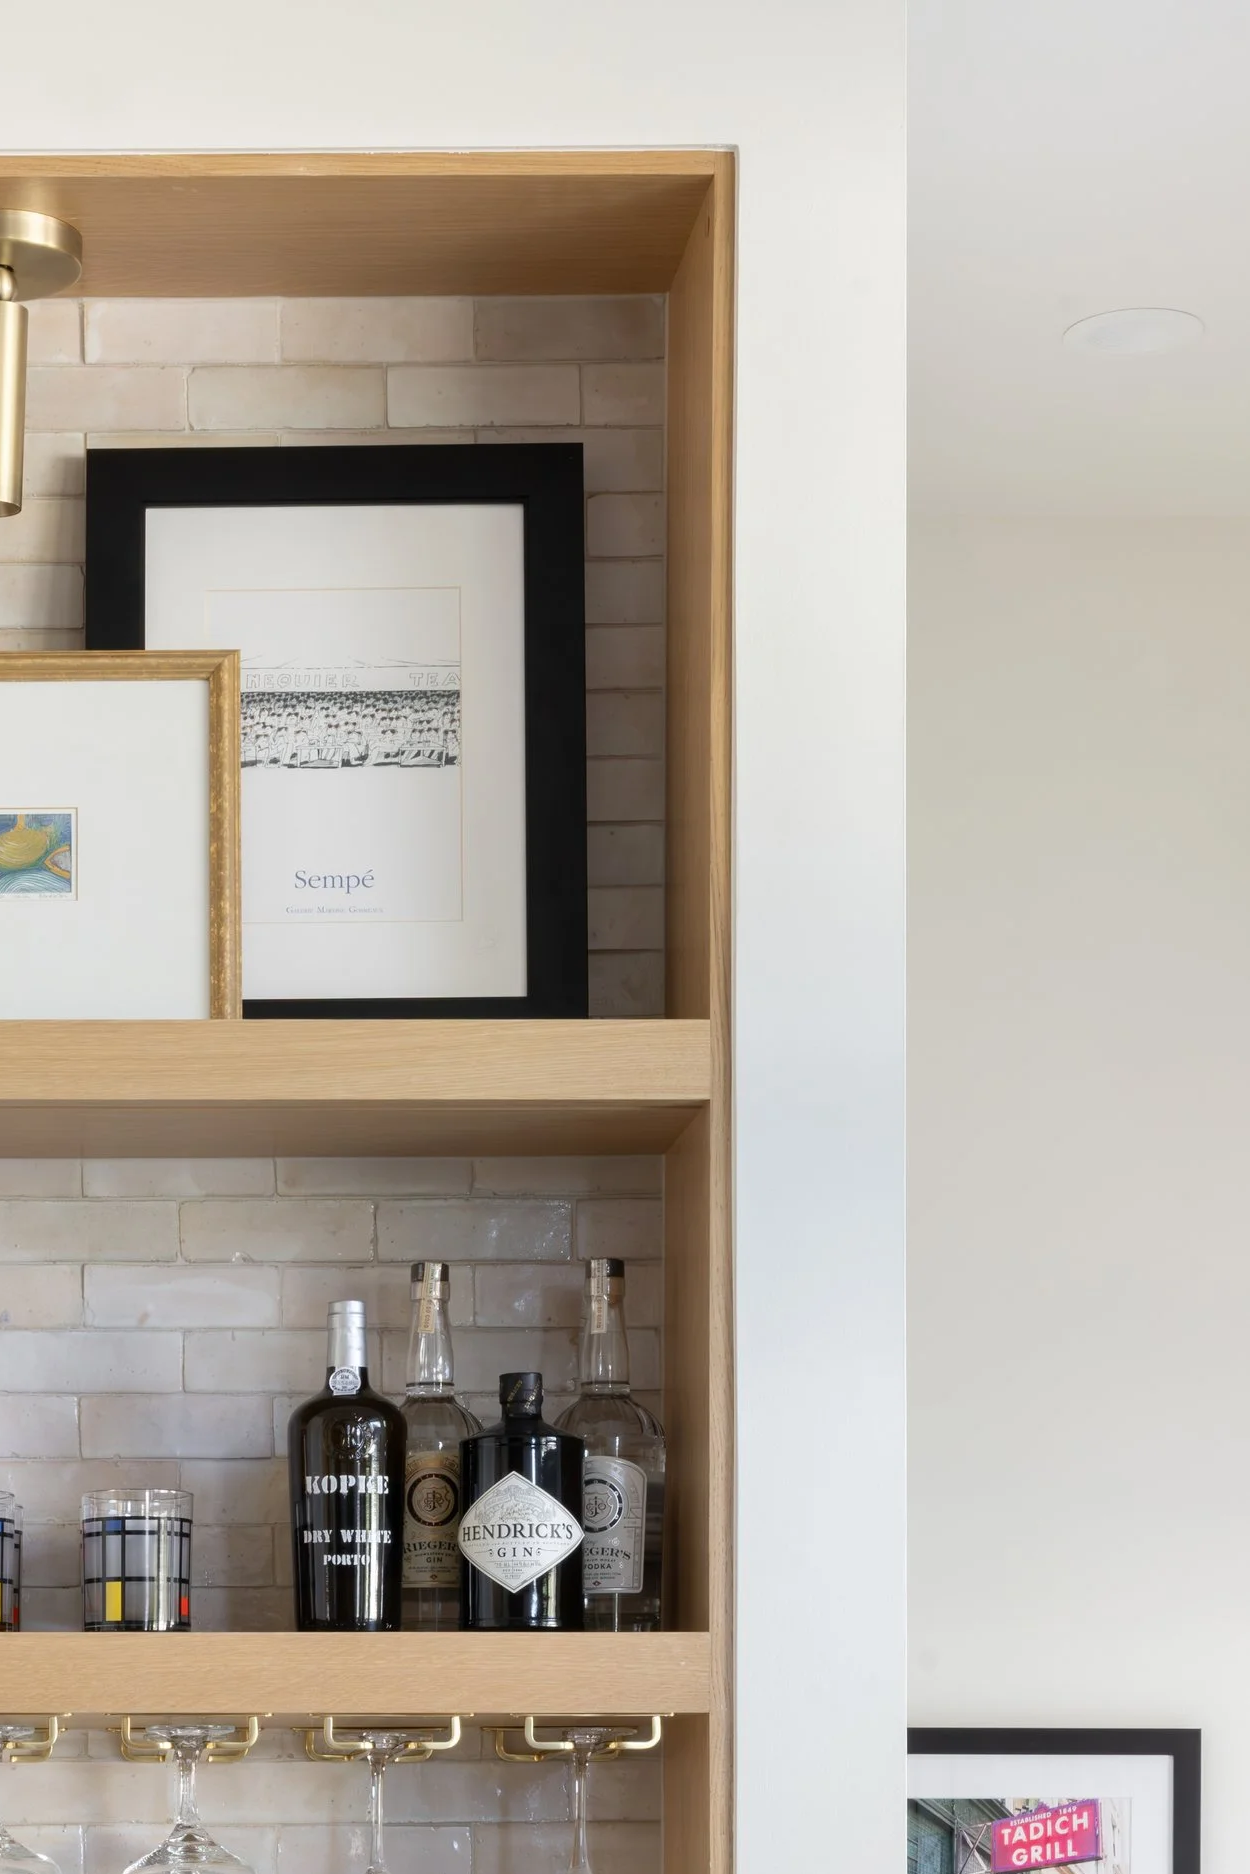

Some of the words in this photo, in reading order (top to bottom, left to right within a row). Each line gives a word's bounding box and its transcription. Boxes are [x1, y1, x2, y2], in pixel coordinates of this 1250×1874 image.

[409, 672, 460, 687] TEA
[294, 869, 375, 894] Sempé
[305, 1474, 389, 1495] KOPKE
[303, 1529, 332, 1544] DRY
[340, 1529, 392, 1544] WHITE
[462, 1522, 573, 1542] HENDRICK'S
[403, 1541, 458, 1554] RIEGER
[497, 1547, 533, 1558] GIN
[583, 1547, 632, 1561] EGER'S
[323, 1554, 371, 1566] PORTO
[426, 1556, 443, 1564] GIN
[1010, 1811, 1052, 1827] ESTABLISHED
[1001, 1811, 1089, 1846] TADICH
[1012, 1839, 1078, 1866] GRILL
